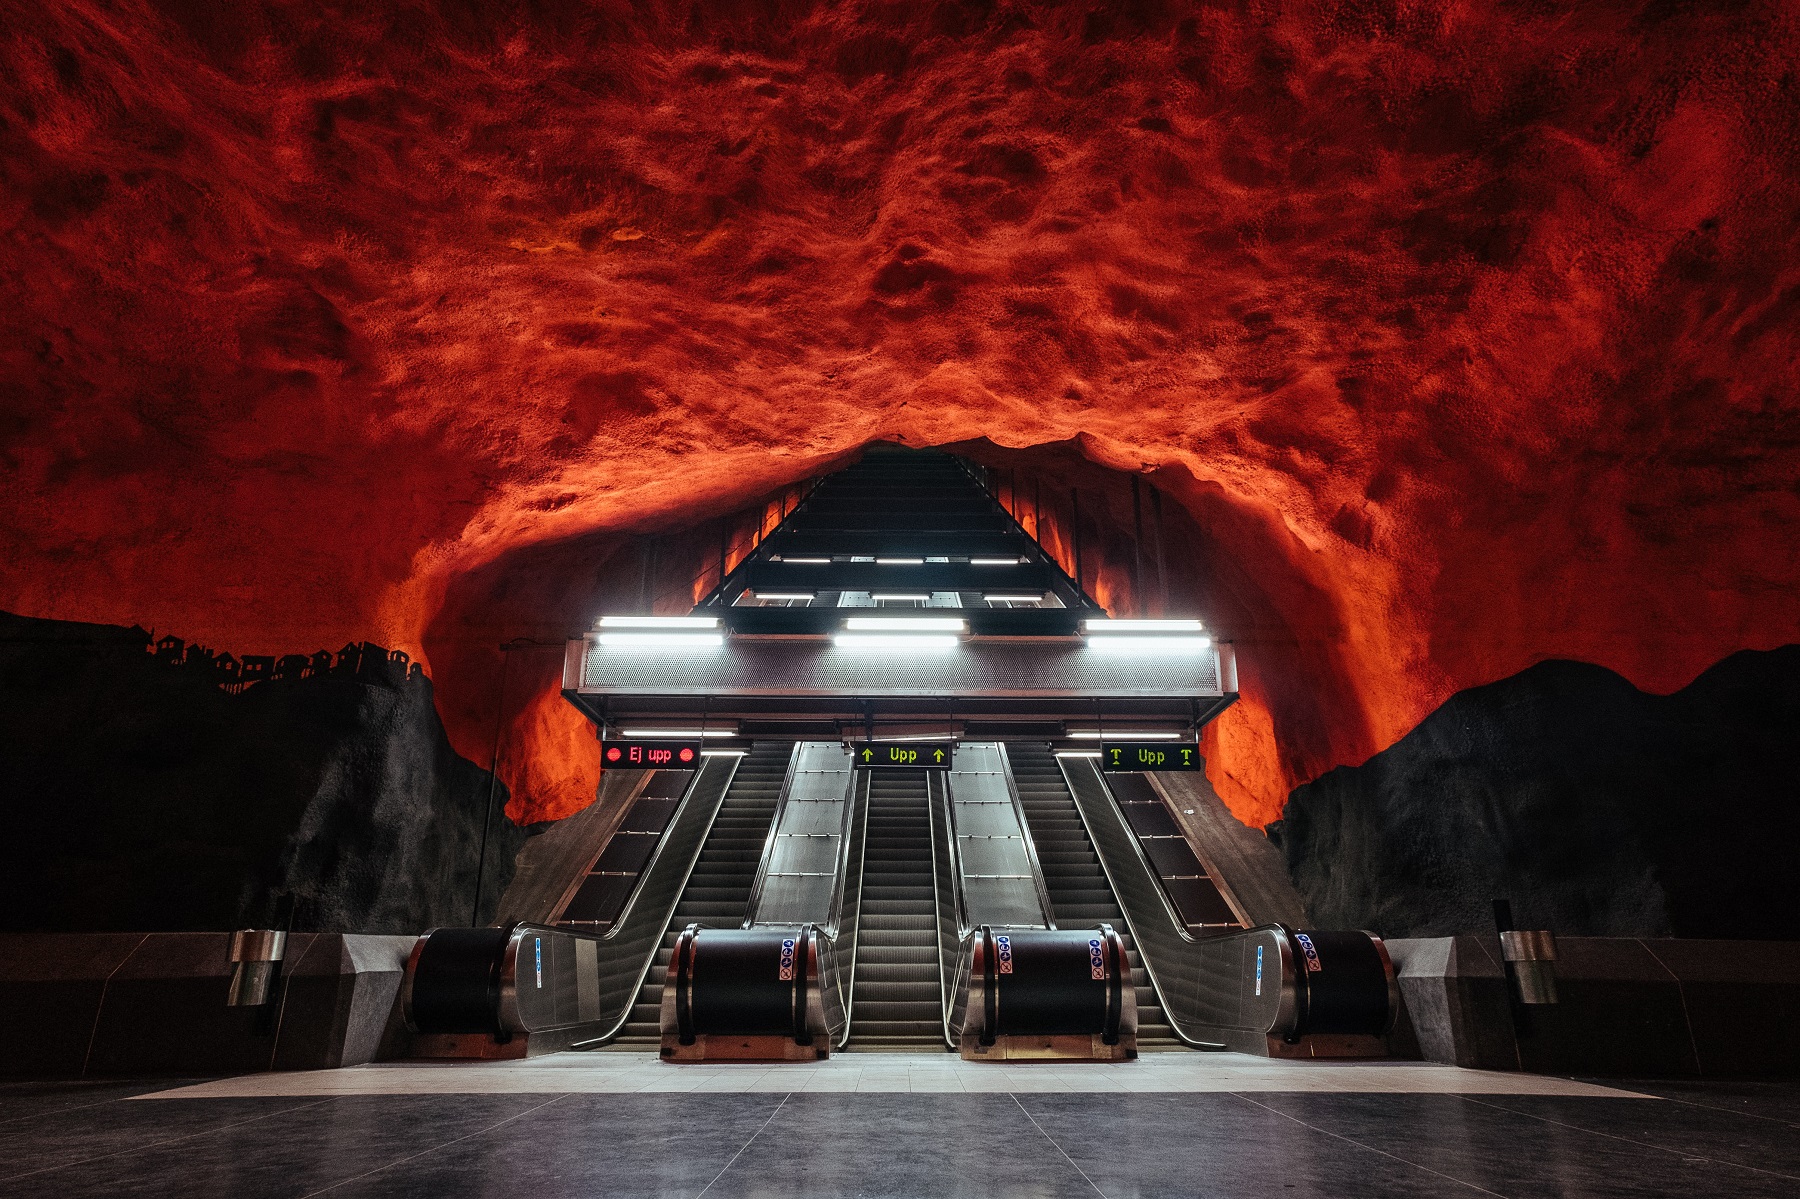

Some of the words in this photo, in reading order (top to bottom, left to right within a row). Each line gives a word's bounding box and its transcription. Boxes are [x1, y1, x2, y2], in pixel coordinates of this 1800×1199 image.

[630, 746, 642, 763] Ej
[648, 750, 671, 763] upp
[890, 747, 917, 763] Upp
[1138, 748, 1165, 765] Upp
